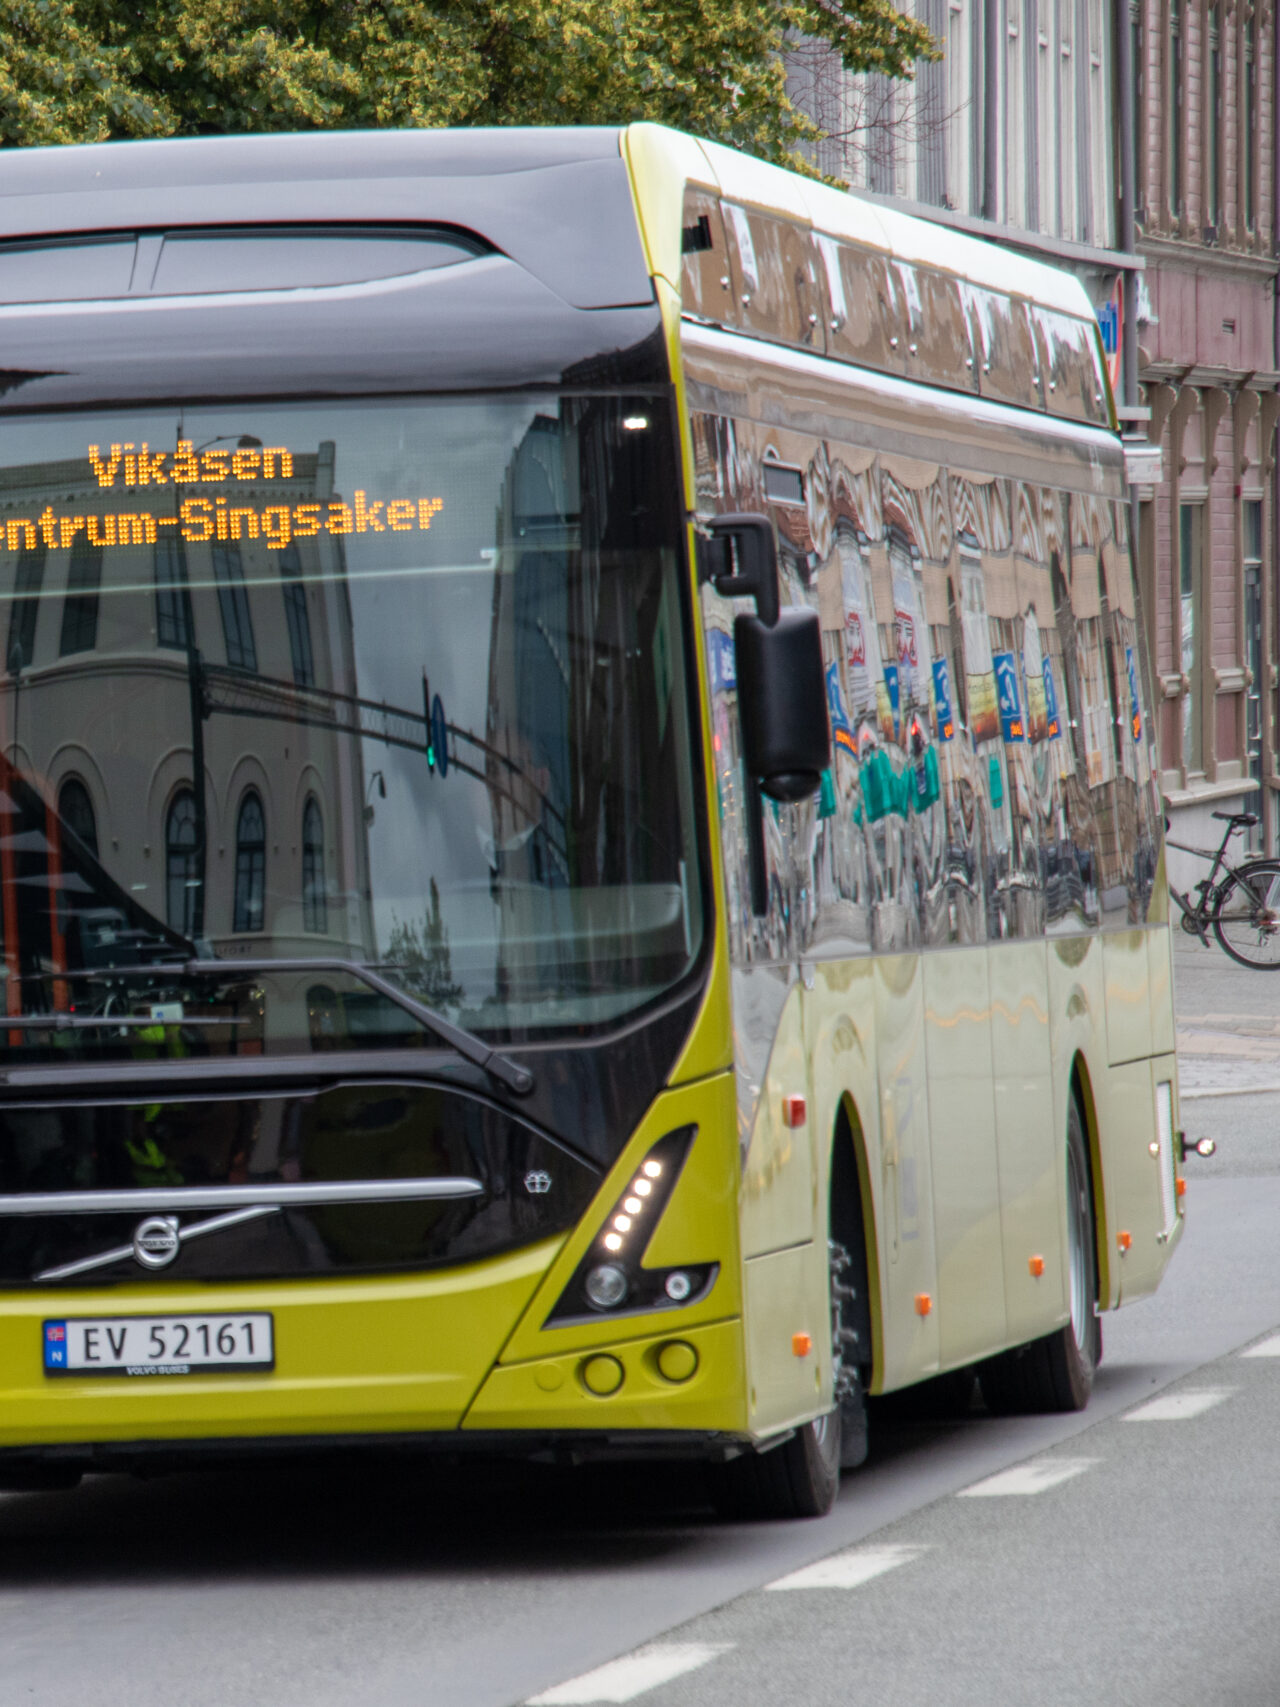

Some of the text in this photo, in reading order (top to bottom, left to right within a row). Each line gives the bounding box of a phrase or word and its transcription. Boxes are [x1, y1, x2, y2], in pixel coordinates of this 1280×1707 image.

[88, 439, 294, 488] Vikåsen
[83, 1322, 255, 1361] EV 52161
[126, 1364, 189, 1376] VOLVO BUSES
